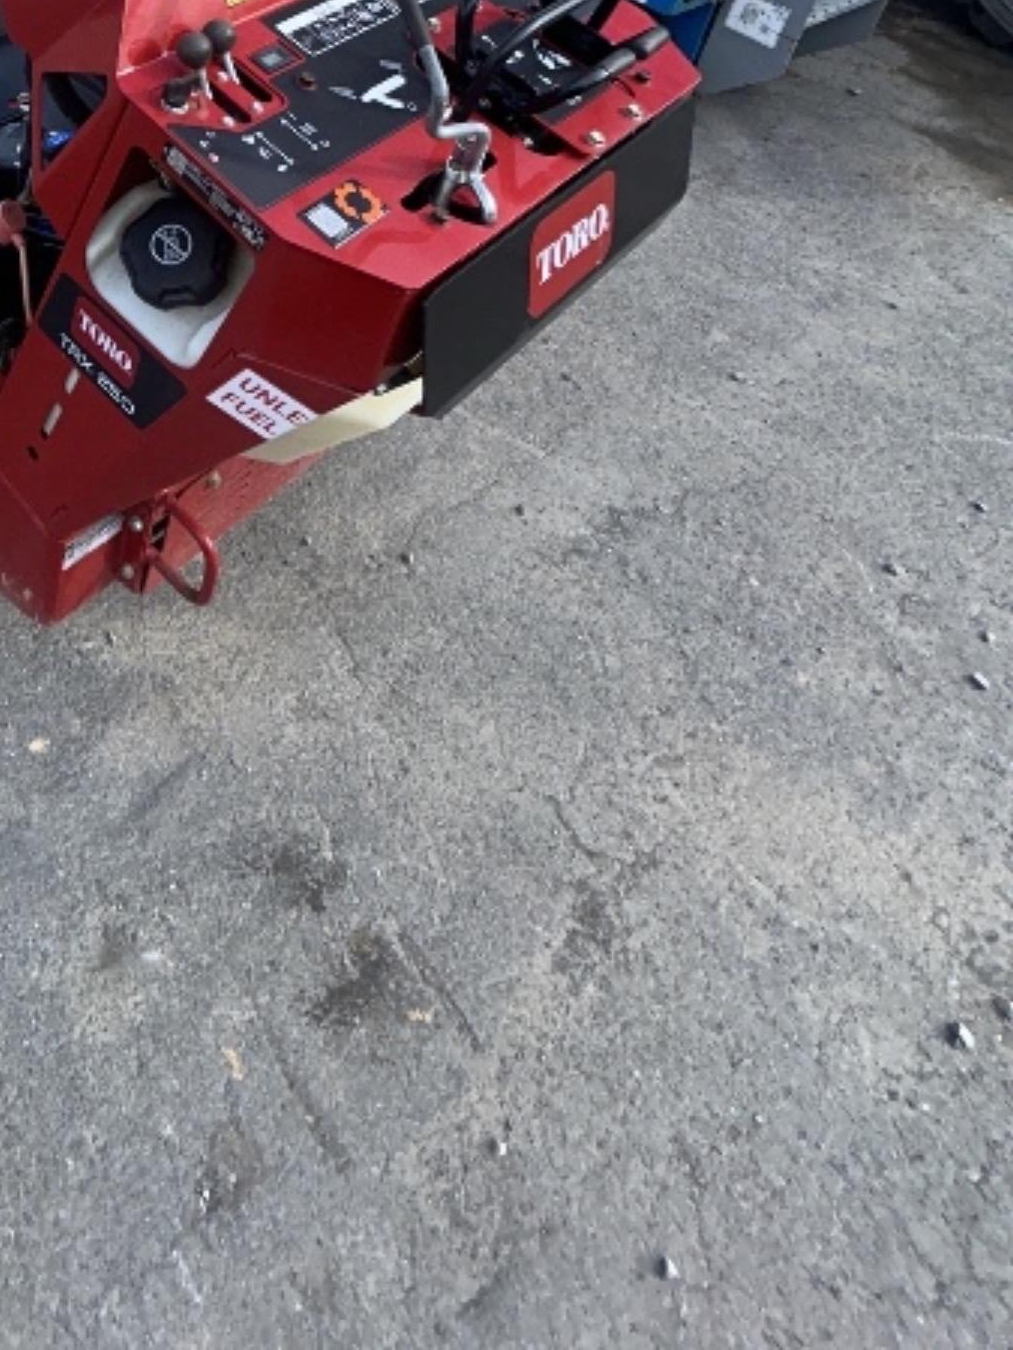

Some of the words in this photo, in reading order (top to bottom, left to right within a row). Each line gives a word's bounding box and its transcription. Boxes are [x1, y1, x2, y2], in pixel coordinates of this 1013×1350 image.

[535, 203, 609, 286] TORO
[78, 309, 133, 373] TORO
[220, 391, 277, 436] FUEL
